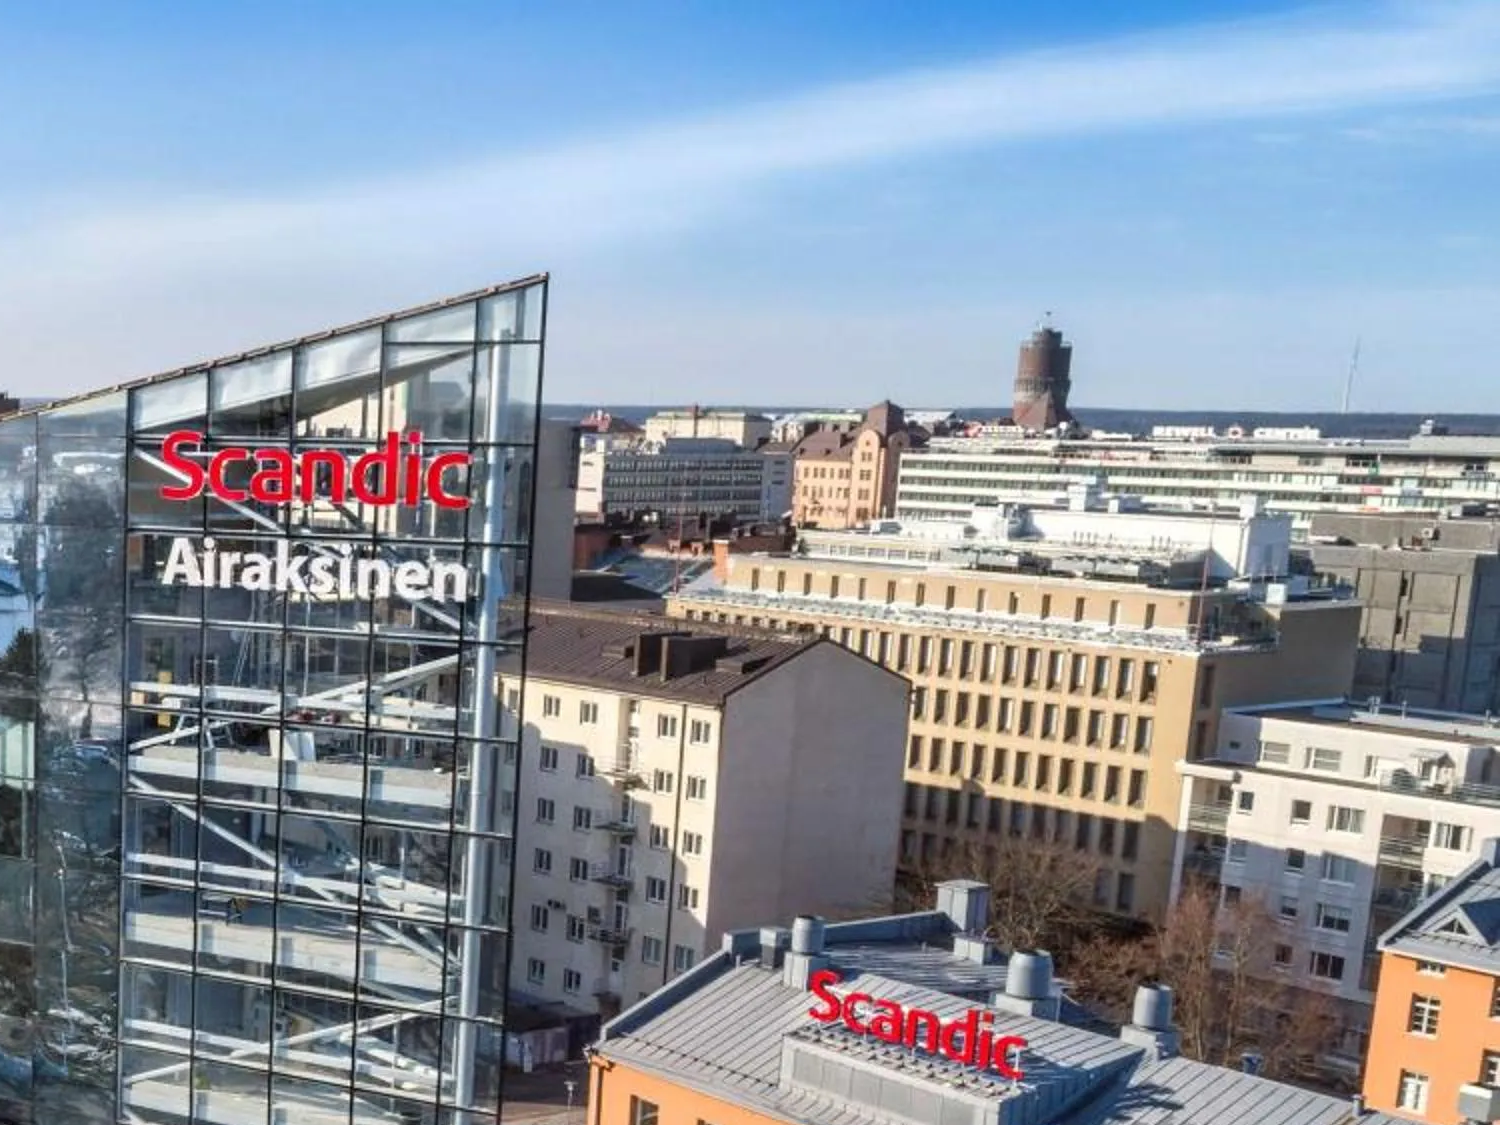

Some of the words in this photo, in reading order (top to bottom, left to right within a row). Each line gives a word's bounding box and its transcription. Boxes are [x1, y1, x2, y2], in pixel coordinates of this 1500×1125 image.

[160, 430, 473, 509] Scandic
[161, 537, 468, 603] Airaksinen
[808, 969, 1029, 1080] Scandic
